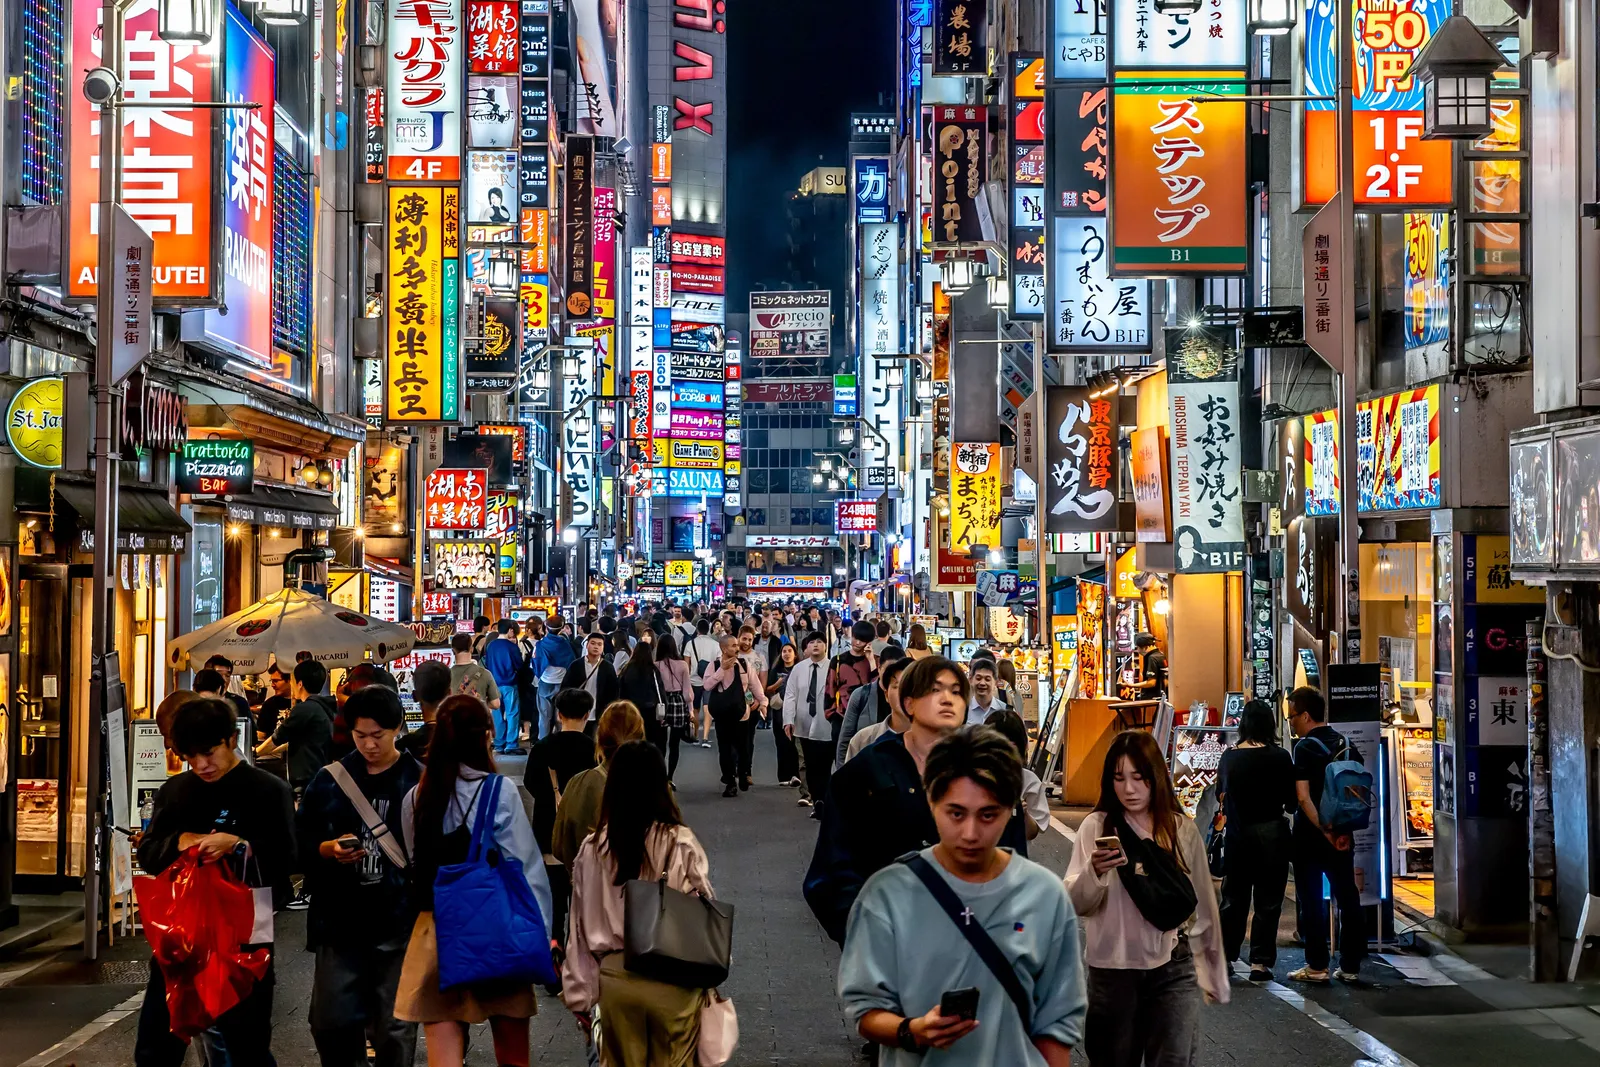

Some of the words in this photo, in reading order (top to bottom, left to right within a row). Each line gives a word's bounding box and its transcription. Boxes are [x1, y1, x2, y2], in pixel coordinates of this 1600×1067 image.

[470, 4, 517, 33] 湖南
[946, 4, 972, 57] 農場
[1362, 10, 1426, 51] 50
[1081, 37, 1098, 45] CAFE
[394, 0, 458, 108] キャバクラ
[485, 61, 502, 71] 4F
[951, 63, 970, 71] 5F
[1016, 60, 1028, 68] 5F
[1373, 51, 1414, 93] 円
[943, 108, 976, 120] 麻雀
[405, 110, 455, 152] J
[1369, 117, 1423, 151] 1F
[1017, 147, 1029, 155] 3F
[406, 158, 442, 180] 4F
[1150, 99, 1210, 243] ステップ
[825, 174, 846, 186] SU
[1366, 164, 1423, 198] 2F
[444, 194, 458, 249] 炭火串焼
[604, 191, 615, 242] キャバクラ
[672, 240, 722, 258] 全店営業中
[1170, 248, 1190, 262] B1
[1408, 221, 1429, 278] 50
[78, 266, 205, 285] AUTEI
[672, 271, 722, 282] MO-MO-PARADISE
[1075, 225, 1110, 342] うまいもん
[1314, 234, 1331, 334] 劇場通り一番街
[125, 246, 142, 345] 劇場通り一番街
[752, 295, 829, 306] コミック&ネットカフェ
[1108, 286, 1143, 317] 屋
[672, 299, 722, 311] FACE
[1004, 323, 1014, 331] 4
[1059, 299, 1075, 343] 一番街
[1114, 329, 1146, 343] B1F
[1004, 343, 1014, 353] 3
[656, 354, 666, 384] GiGO
[671, 353, 723, 368] ビリヤード&ダーツ
[1003, 365, 1013, 376] 2
[775, 393, 817, 401] ハンバーグ
[838, 405, 847, 413] 酒
[1003, 407, 1017, 421] B1
[1174, 396, 1188, 449] HIROSHIMA
[1023, 412, 1032, 464] 劇場通り一番街
[1088, 399, 1112, 489] 東京豚骨
[183, 442, 249, 459] Trattoria
[674, 442, 692, 456] GAME
[693, 442, 712, 457] PANIC
[958, 448, 988, 466] 新宿
[184, 460, 244, 478] Pizzeria
[968, 464, 979, 473] の
[1193, 393, 1239, 528] お好み焼き
[200, 477, 227, 492] Bar
[428, 470, 484, 501] 湖南
[669, 470, 724, 489] SAUNA
[428, 502, 440, 528] 4F
[840, 504, 877, 516] 24時間
[956, 475, 979, 545] まっちゃん
[840, 516, 877, 529] 営業中
[755, 536, 786, 546] コーヒー
[807, 536, 830, 546] クール
[1209, 551, 1243, 567] B1F
[941, 566, 965, 574] ONLINE
[1466, 556, 1475, 581] 5F
[957, 575, 967, 583] B1
[1466, 628, 1475, 652] 4F
[1498, 686, 1528, 697] 麻雀・
[1468, 698, 1477, 723] 3F
[1490, 698, 1528, 726] 東
[1468, 771, 1476, 795] B1
